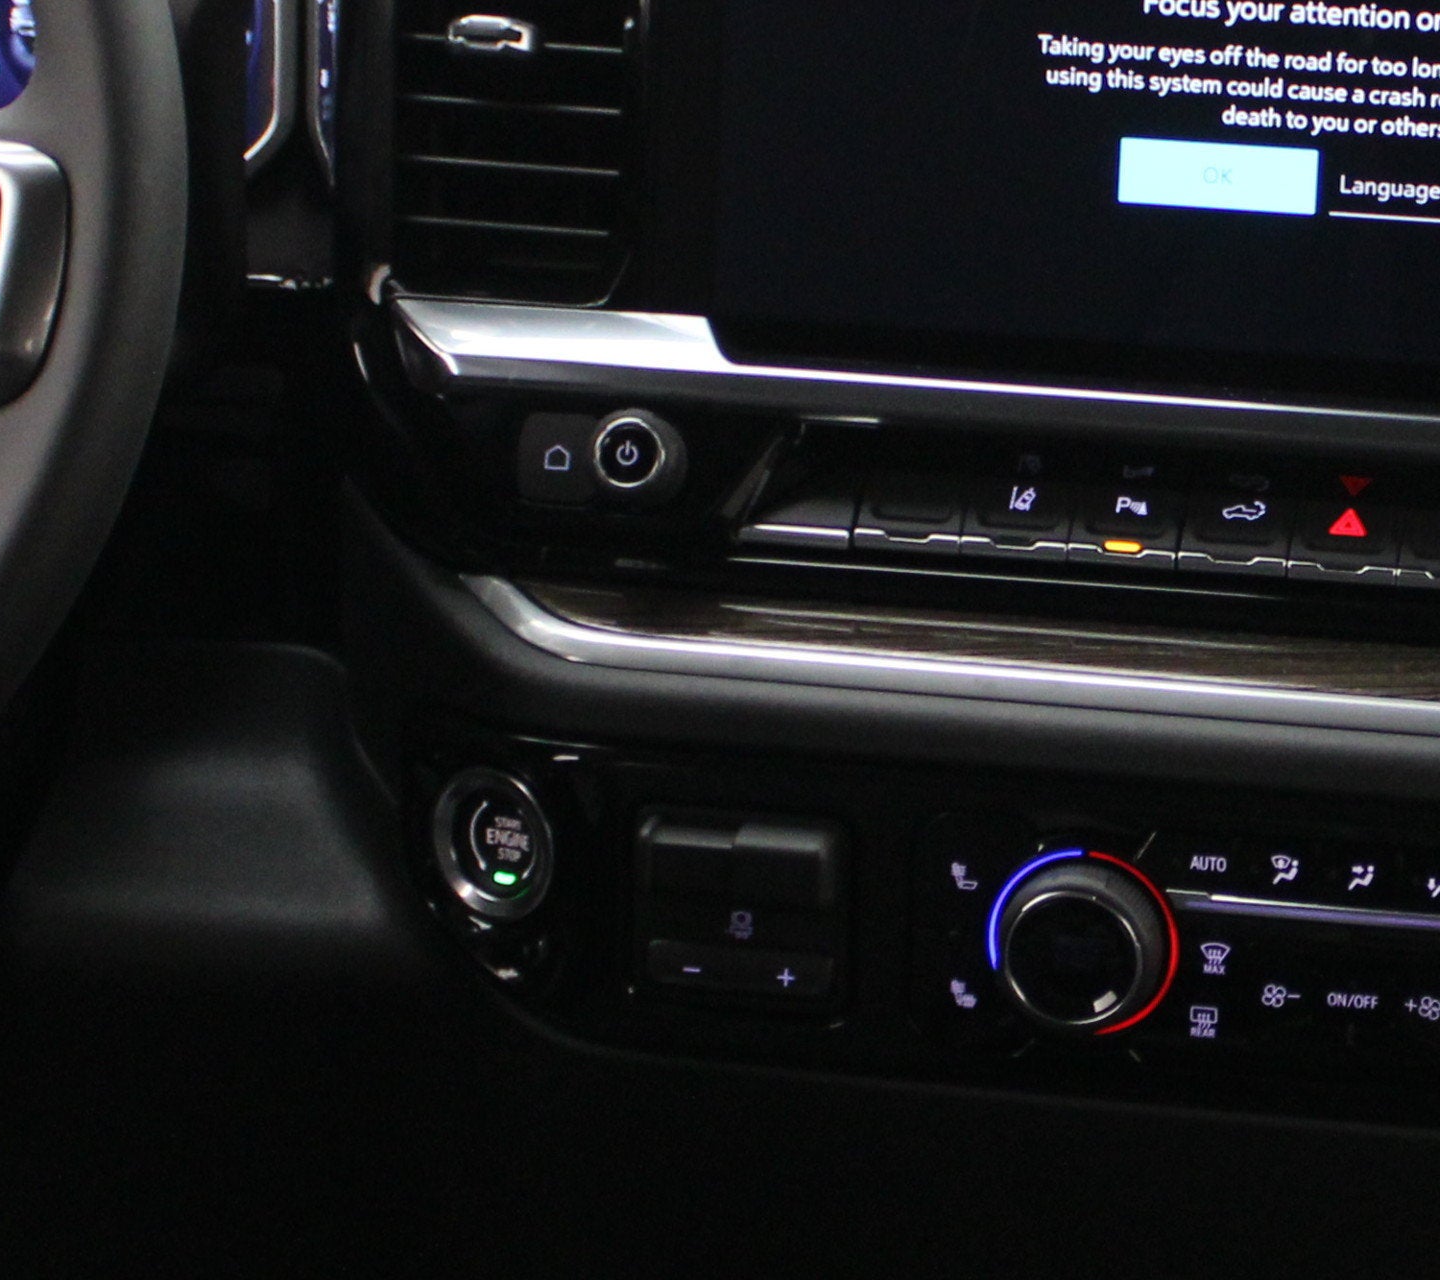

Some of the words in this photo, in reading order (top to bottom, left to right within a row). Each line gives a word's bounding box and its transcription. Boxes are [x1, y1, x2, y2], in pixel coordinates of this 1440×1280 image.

[1225, 1, 1285, 26] your
[1290, 1, 1410, 29] attention
[1038, 34, 1104, 63] Taking
[1108, 44, 1155, 64] your
[1158, 47, 1206, 68] eyes
[1210, 45, 1243, 66] off
[1245, 47, 1280, 68] the
[1284, 51, 1332, 72] road
[1336, 52, 1368, 73] for
[1371, 57, 1407, 76] too
[1046, 67, 1102, 92] using
[1106, 68, 1145, 90] this
[1149, 74, 1222, 97] system
[1226, 77, 1283, 98] could
[1287, 85, 1348, 102] cause
[1352, 88, 1365, 103] a
[1369, 86, 1426, 107] crash
[1222, 104, 1281, 127] death
[1286, 111, 1308, 129] to
[1311, 116, 1349, 136] you
[1354, 119, 1377, 133] or
[1202, 166, 1233, 185] OK
[1339, 174, 1440, 205] Language
[485, 827, 530, 852] ENGINE
[497, 847, 522, 862] STOP
[1190, 856, 1227, 872] AUTO
[1203, 964, 1226, 975] MAX
[1327, 992, 1378, 1009] ON/OFF
